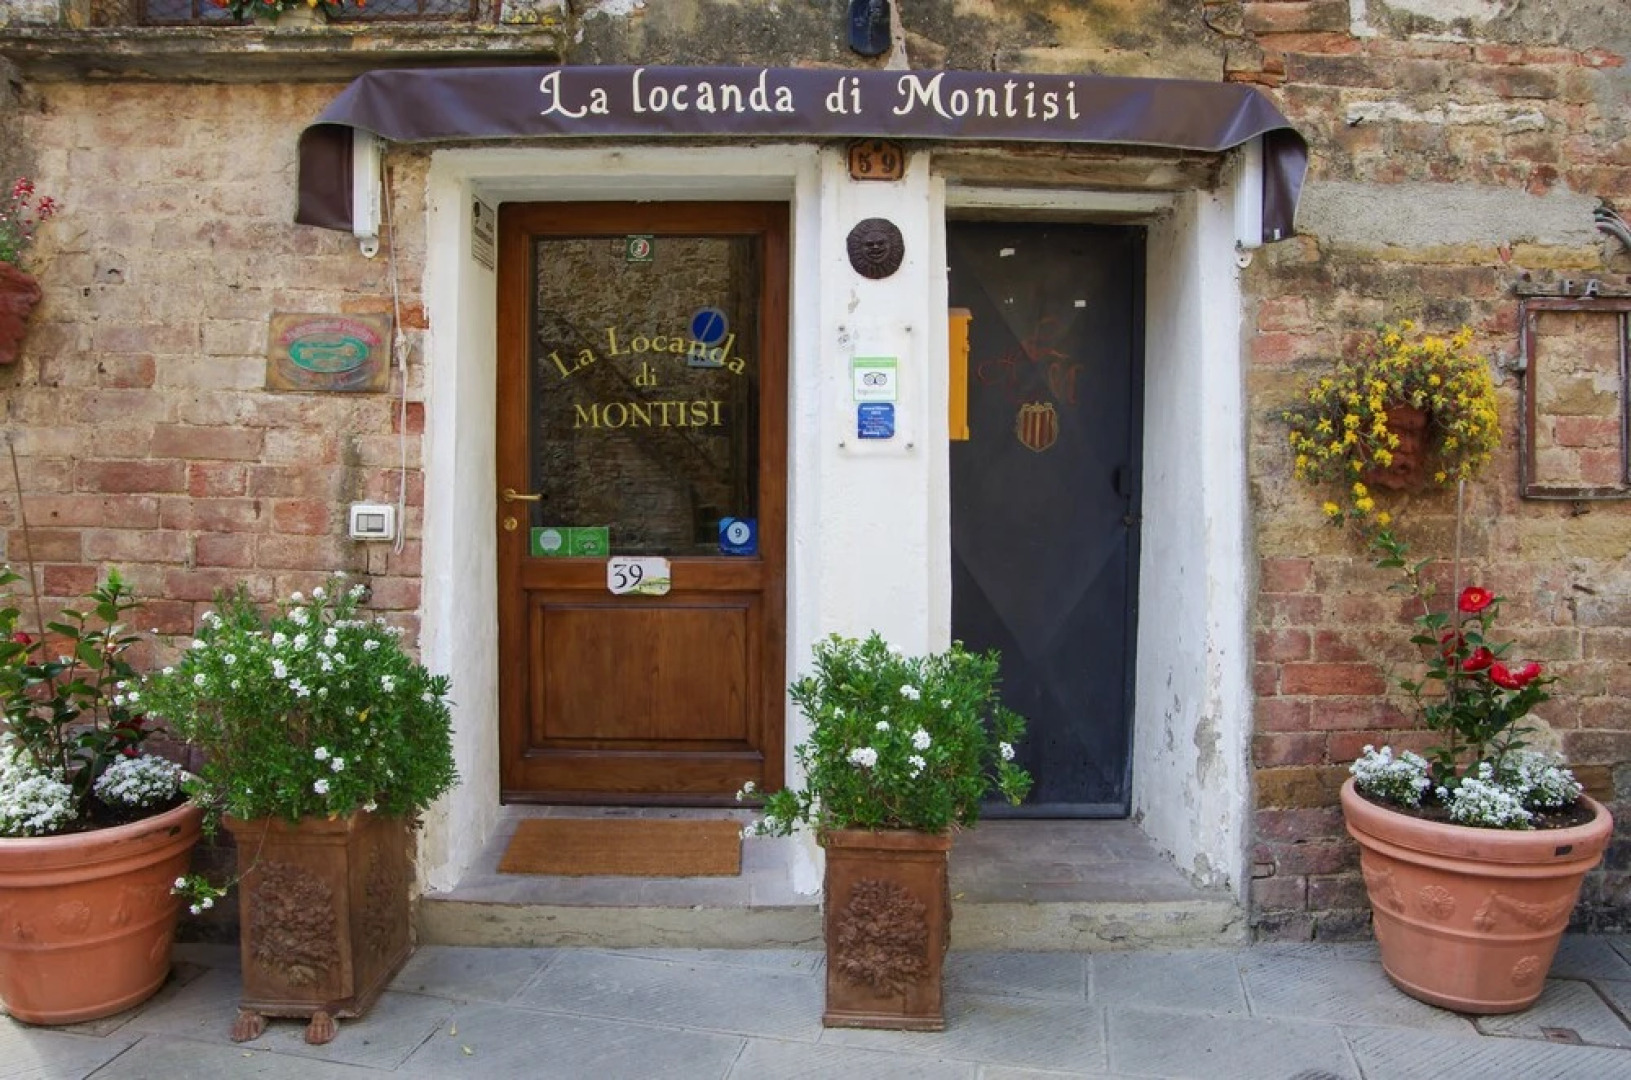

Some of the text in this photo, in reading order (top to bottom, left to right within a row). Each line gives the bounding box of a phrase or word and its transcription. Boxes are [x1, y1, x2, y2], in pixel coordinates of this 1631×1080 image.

[540, 67, 1080, 121] La locanda di Montisi
[548, 327, 746, 380] La Locanda
[635, 361, 658, 387] di
[573, 400, 724, 430] MONTISI
[734, 527, 743, 539] 9
[612, 563, 644, 590] 39
